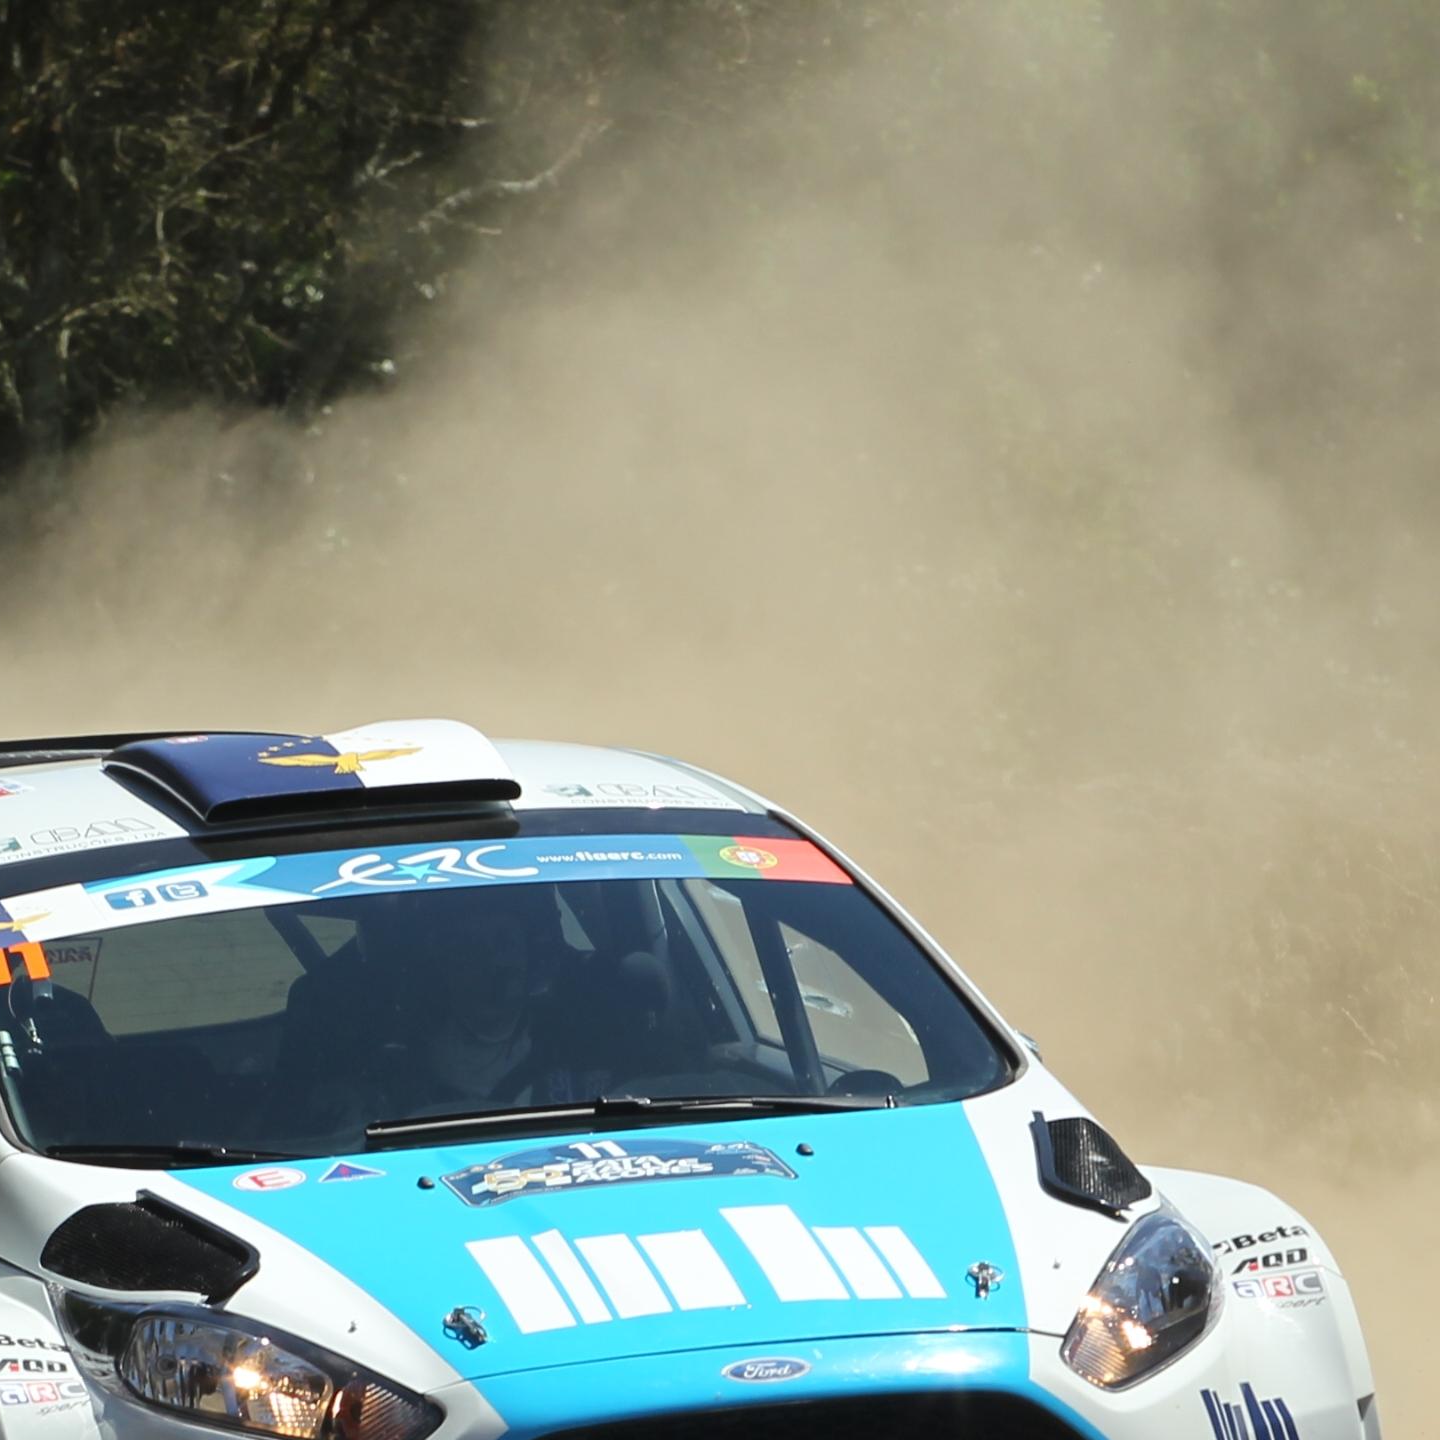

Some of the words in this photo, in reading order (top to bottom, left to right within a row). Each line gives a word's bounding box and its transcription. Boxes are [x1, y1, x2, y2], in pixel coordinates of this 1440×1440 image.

[569, 1139, 628, 1160] 11
[1231, 1225, 1311, 1250] Beta
[743, 1361, 792, 1379] Ford
